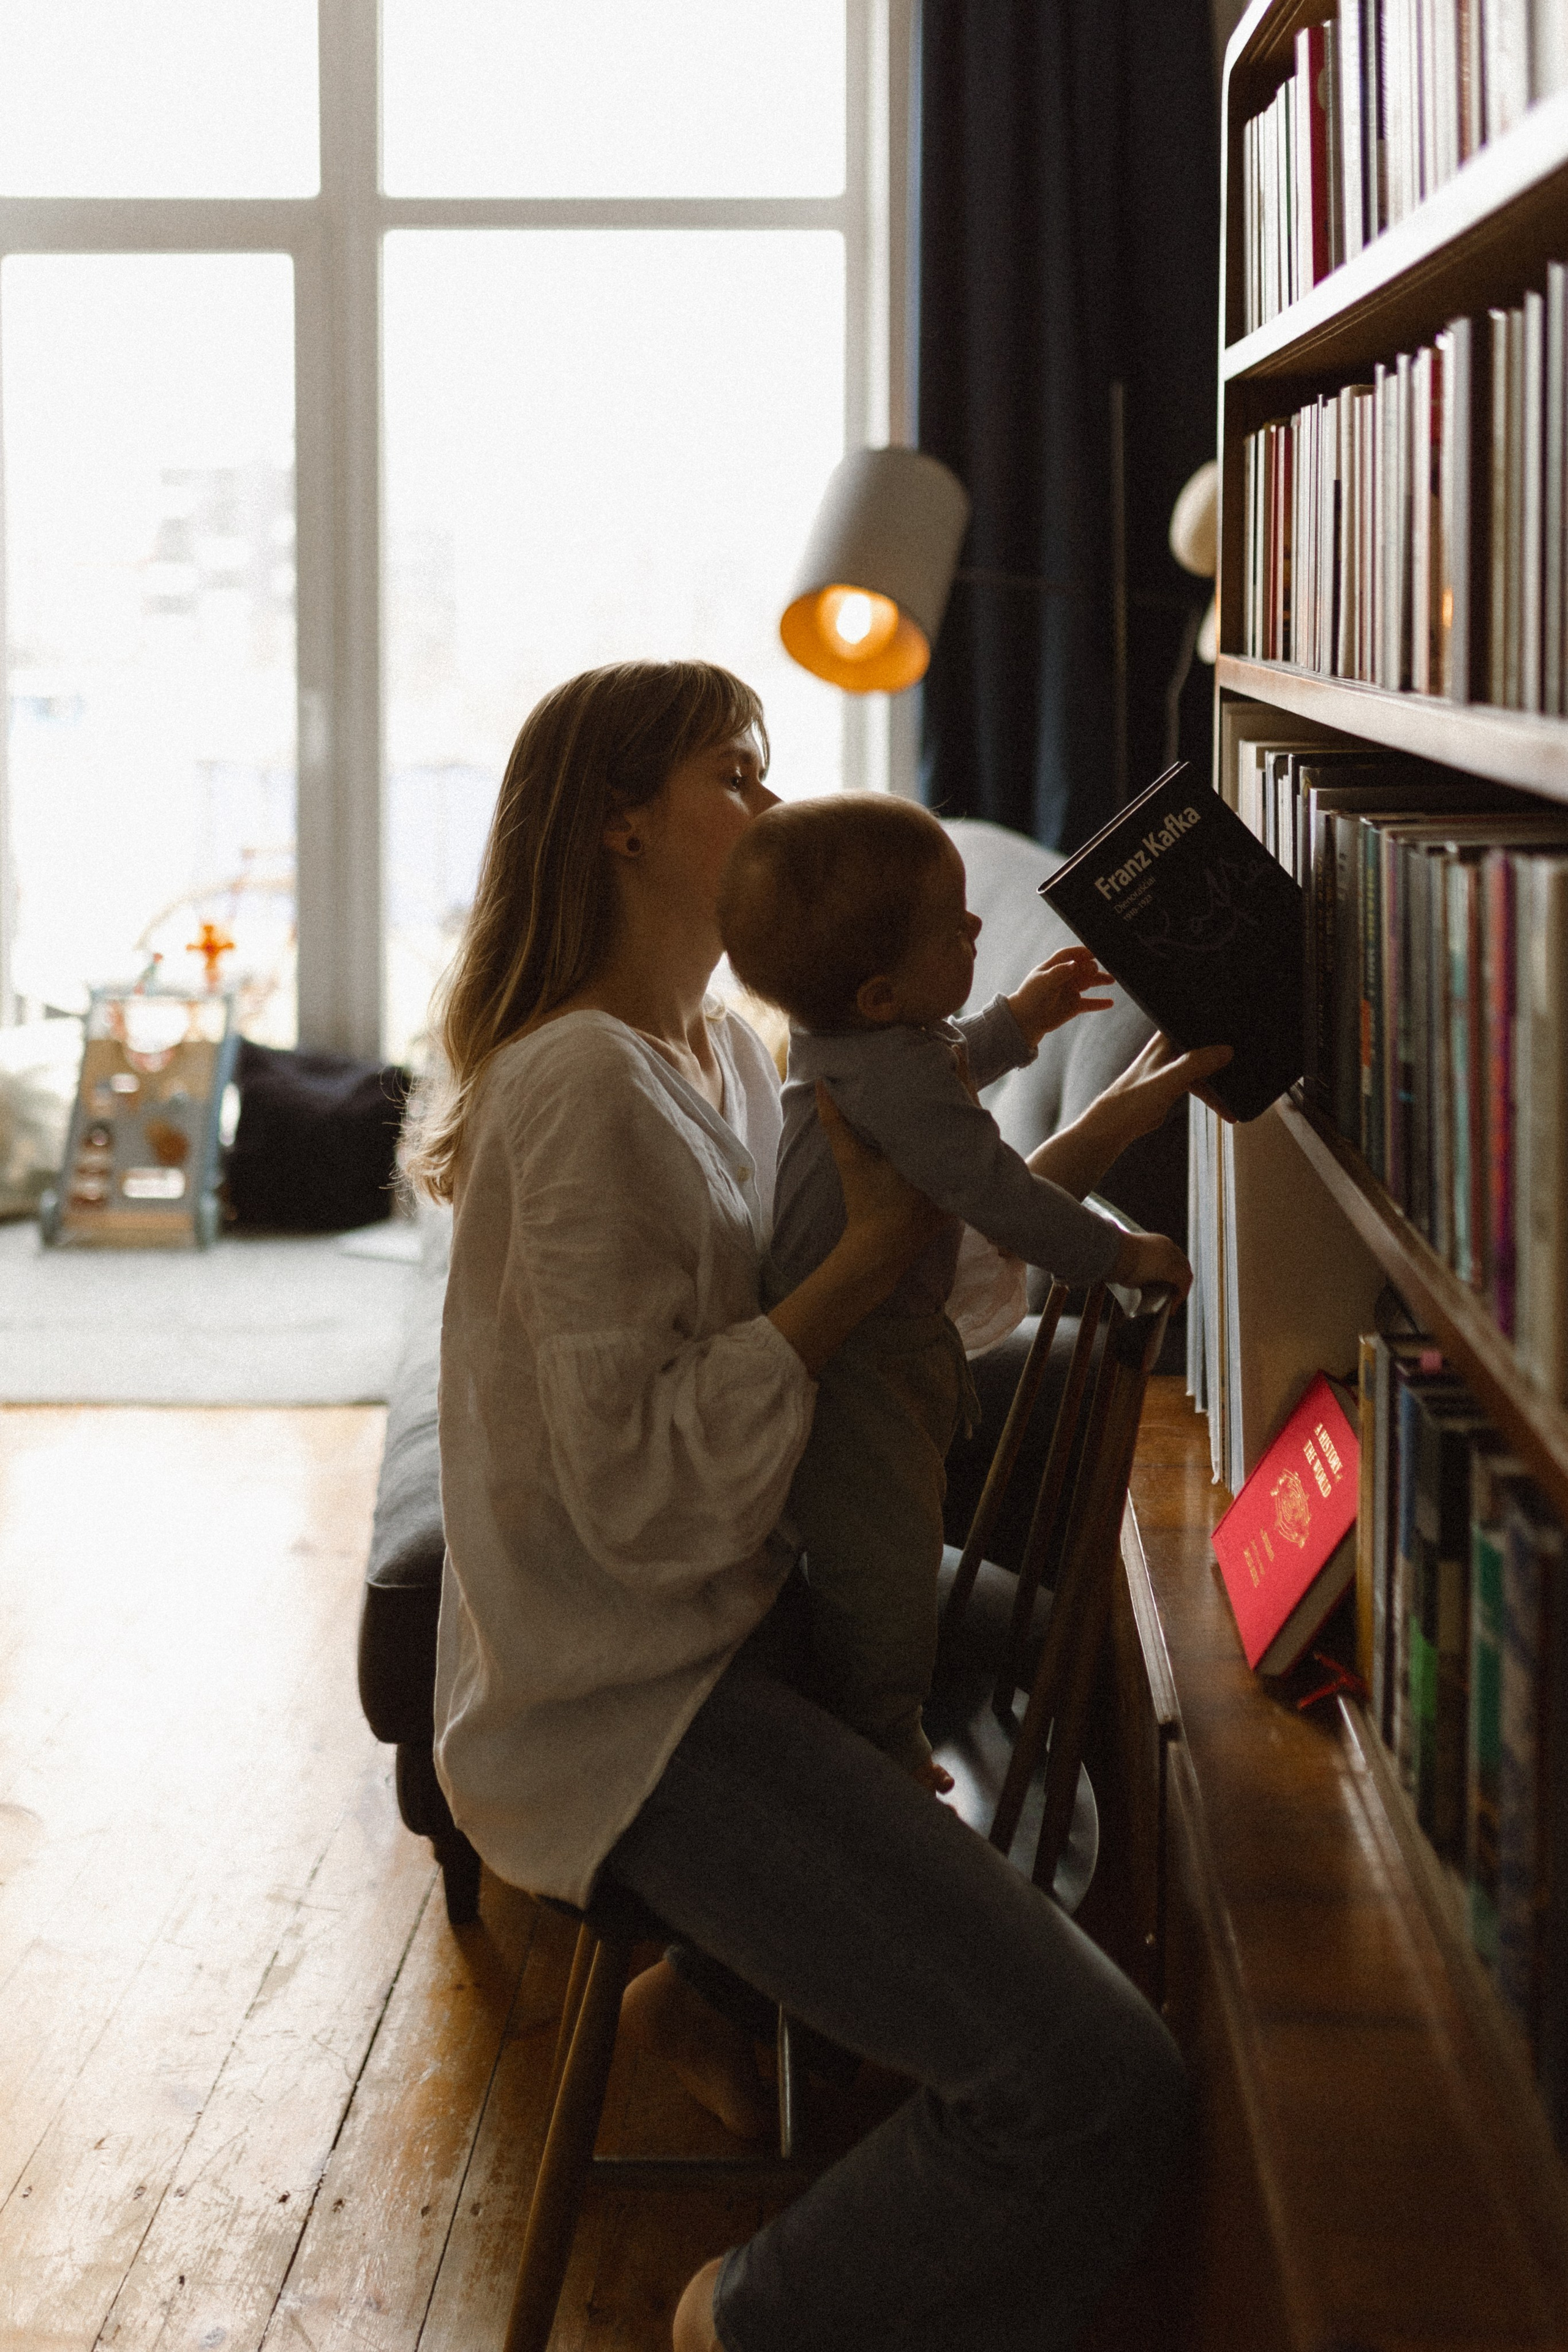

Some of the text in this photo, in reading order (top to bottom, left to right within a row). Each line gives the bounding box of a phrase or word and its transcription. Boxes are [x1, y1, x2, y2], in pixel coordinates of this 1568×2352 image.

[1094, 807, 1201, 900] Franz Kafka
[1314, 1423, 1323, 1436] A
[1317, 1429, 1343, 1475] HISTORY
[1303, 1439, 1332, 1498] THE WORLD
